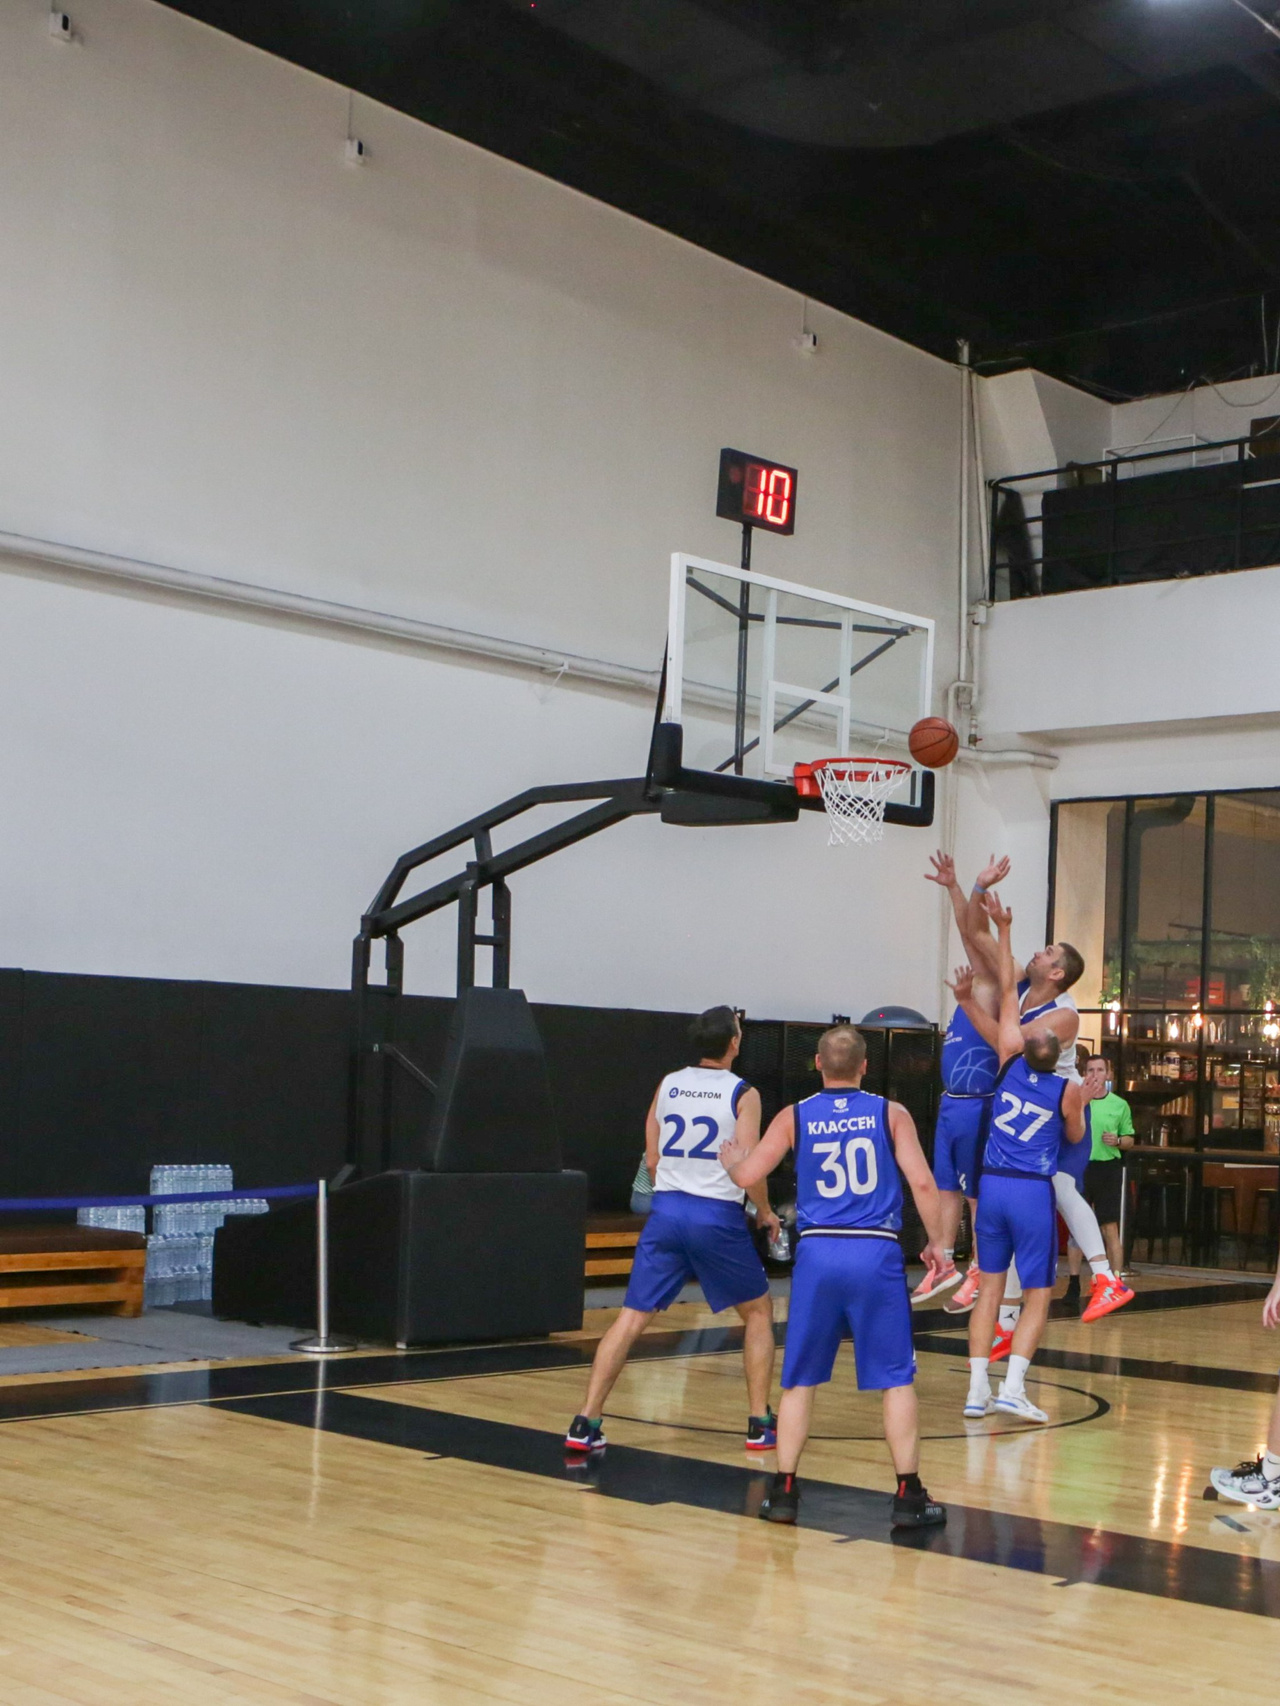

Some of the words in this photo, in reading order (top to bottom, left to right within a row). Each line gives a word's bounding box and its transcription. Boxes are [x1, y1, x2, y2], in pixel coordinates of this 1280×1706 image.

[757, 469, 791, 525] 10
[680, 1090, 722, 1100] РОСАТОМ
[994, 1091, 1054, 1142] 27
[662, 1113, 719, 1161] 22
[807, 1115, 876, 1135] КЛАССЕН
[812, 1137, 878, 1198] 30
